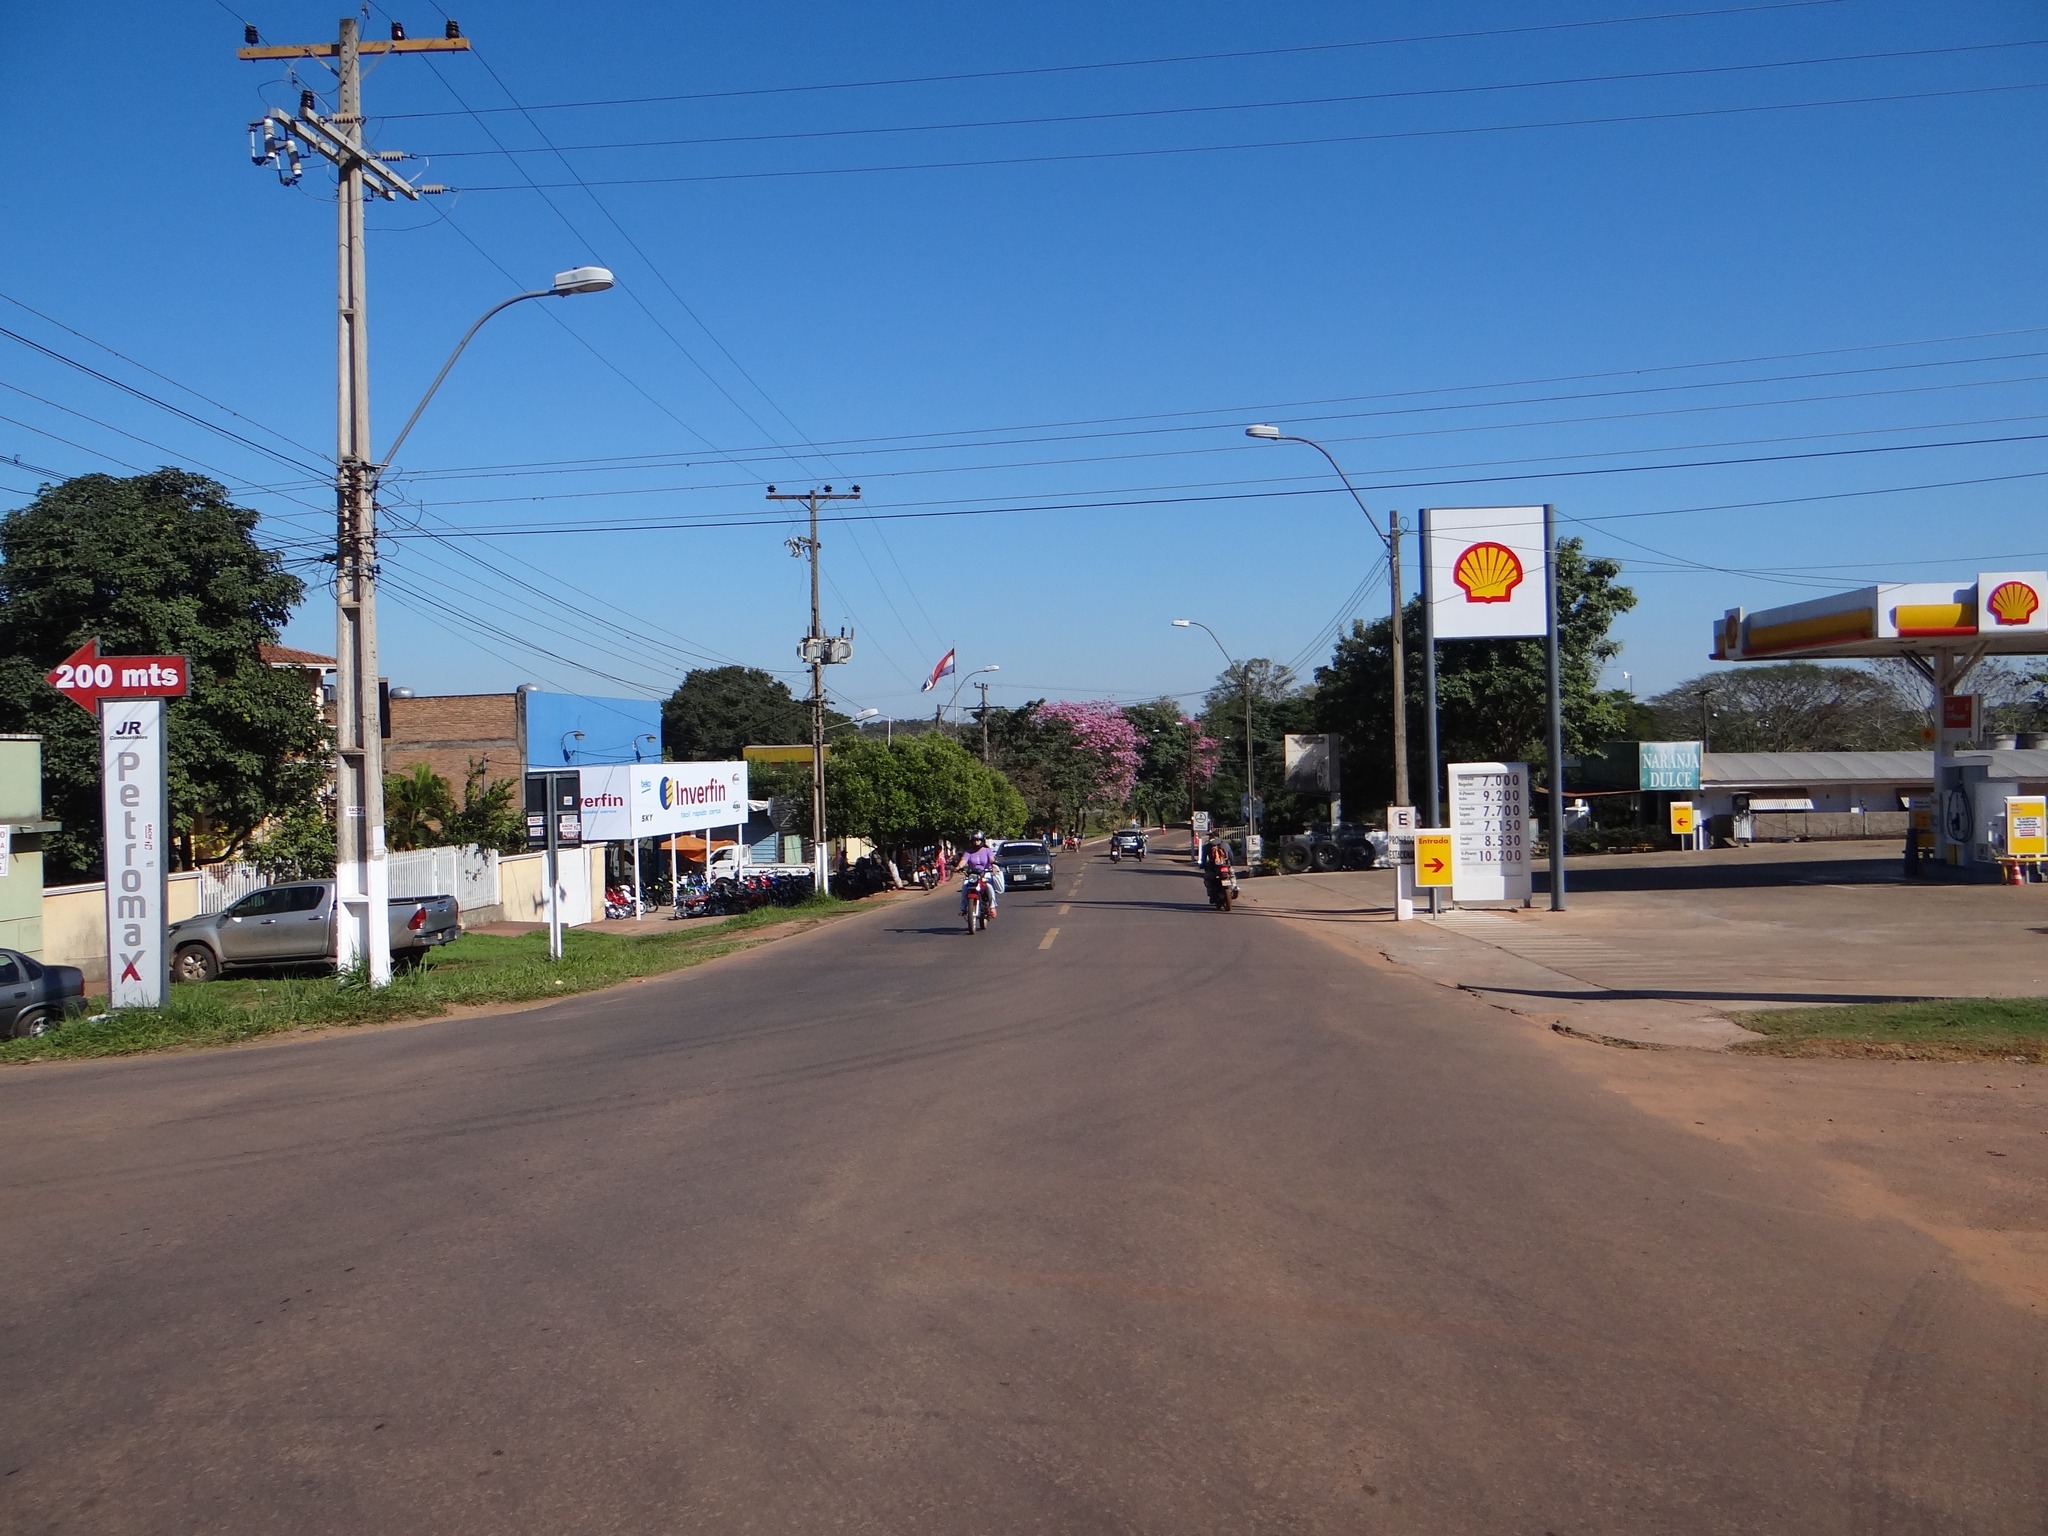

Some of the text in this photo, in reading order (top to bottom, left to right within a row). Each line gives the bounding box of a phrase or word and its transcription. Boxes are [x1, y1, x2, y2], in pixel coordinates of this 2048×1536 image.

[56, 663, 179, 689] 200 mts
[115, 721, 142, 735] JR
[1642, 752, 1700, 769] NARANJA
[1482, 774, 1519, 787] 7.000
[1649, 771, 1693, 788] DULCE
[675, 778, 726, 806] Inverfin
[1483, 789, 1520, 802] 9.200
[1483, 804, 1520, 817] 7.700
[1398, 813, 1408, 826] E
[1484, 819, 1521, 832] 7.150
[1418, 837, 1449, 845] Entrada
[1484, 834, 1521, 847] 8.530
[1478, 849, 1522, 862] 10.200
